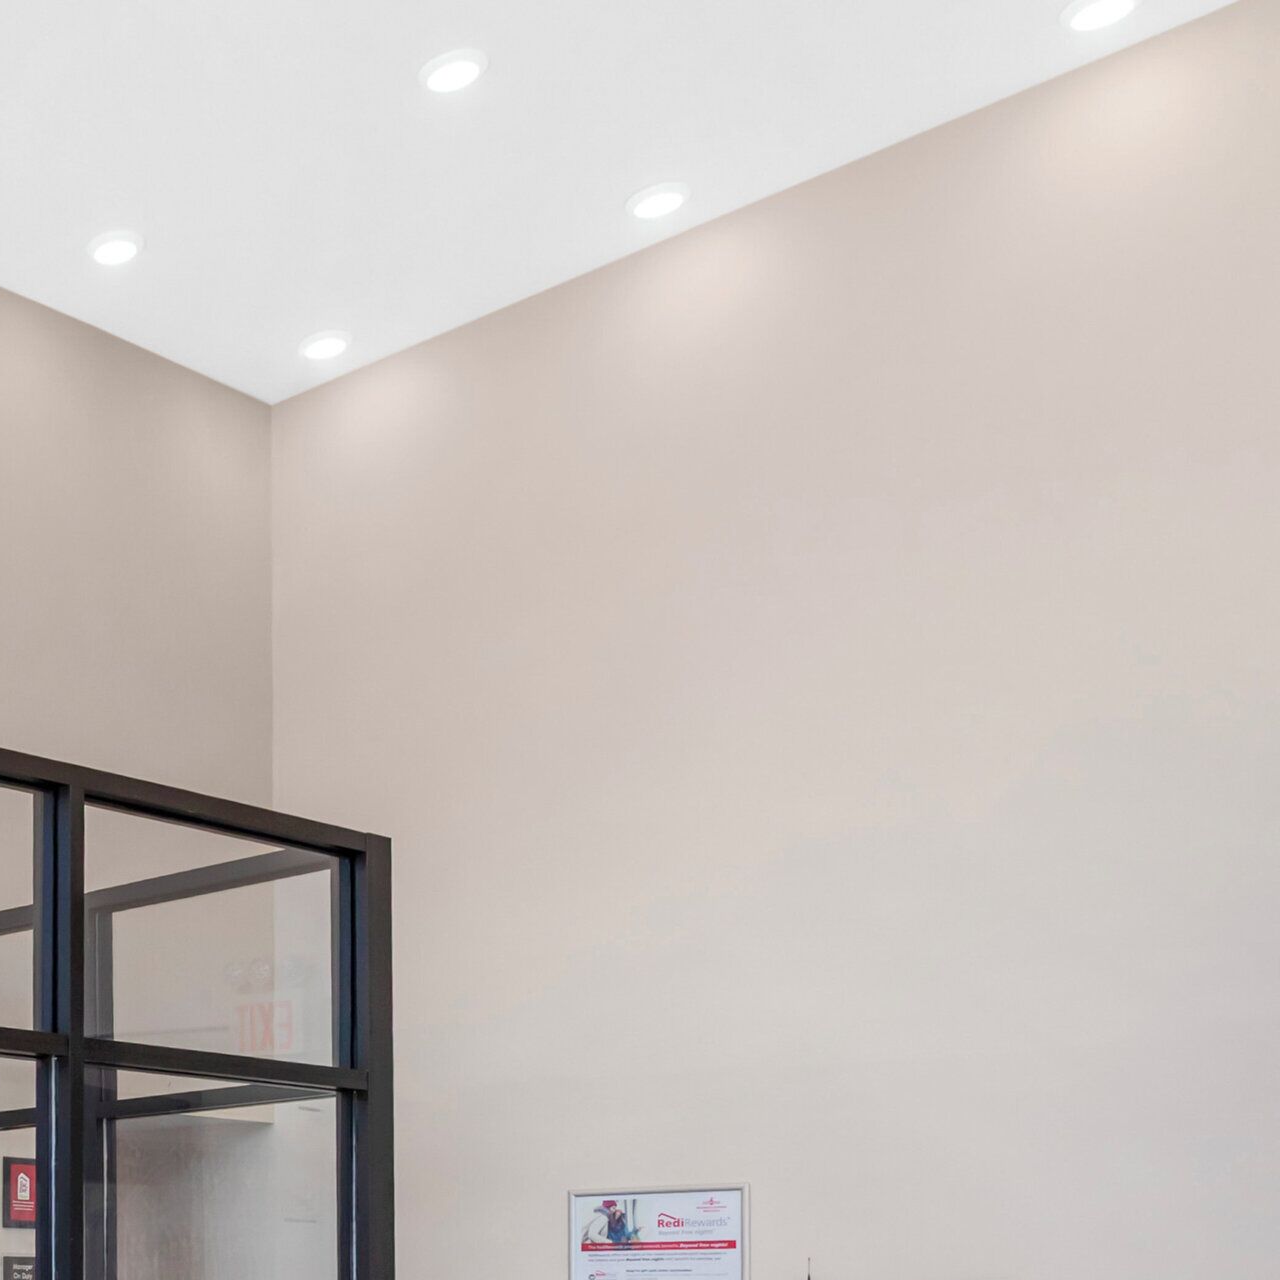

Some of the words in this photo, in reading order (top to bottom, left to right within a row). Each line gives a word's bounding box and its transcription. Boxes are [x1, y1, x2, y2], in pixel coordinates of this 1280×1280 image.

[657, 1215, 728, 1228] RediRewards
[13, 1272, 21, 1280] On
[22, 1272, 32, 1280] Duty
